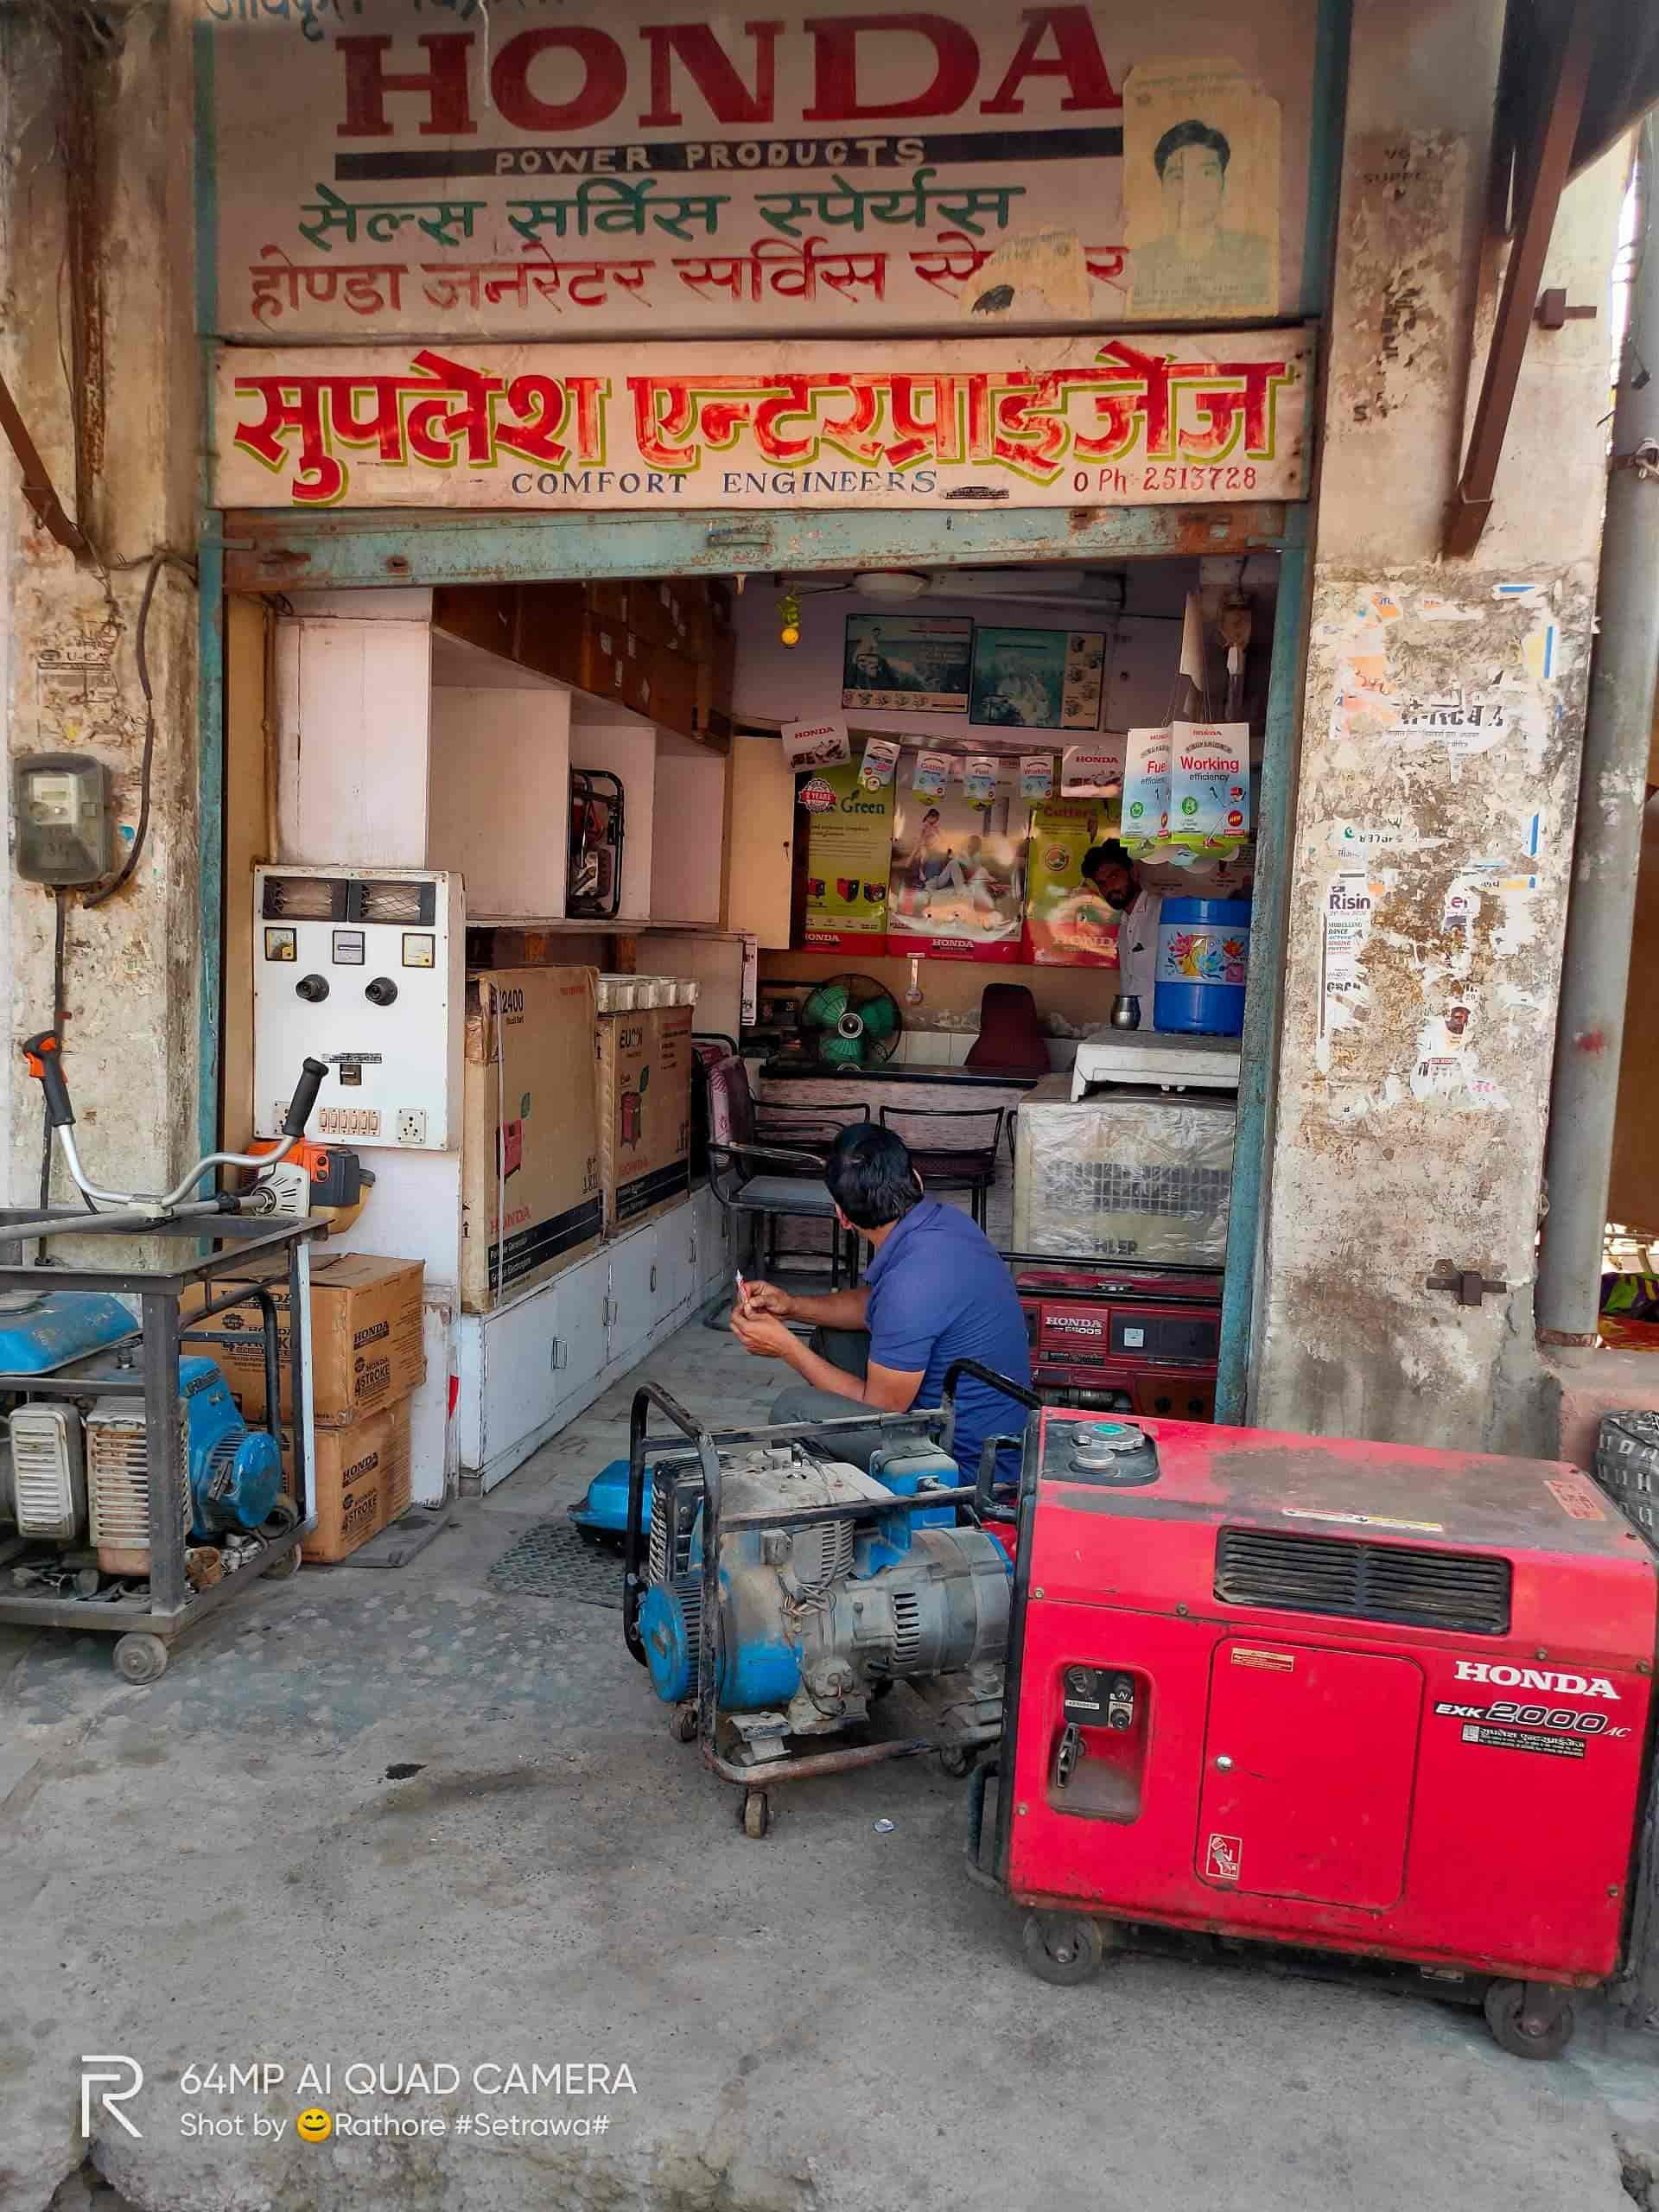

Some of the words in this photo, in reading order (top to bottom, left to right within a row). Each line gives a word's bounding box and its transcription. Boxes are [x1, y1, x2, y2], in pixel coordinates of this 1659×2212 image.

[335, 4, 1123, 137] HONDA
[494, 145, 650, 176] POWER
[686, 137, 928, 170] PRODUCTS
[297, 181, 487, 251] सेल्स
[505, 176, 731, 242] सर्विस
[249, 245, 409, 331] होण्डा
[421, 242, 656, 314] जनरेटर
[671, 234, 890, 304] सर्विस
[233, 348, 613, 507] सुपलेश
[511, 472, 688, 495] COMFORT
[722, 468, 939, 494] ENGINEERS
[1142, 466, 1257, 491] 2513728
[1076, 755, 1120, 765] HONDA
[1180, 755, 1240, 774] Working
[1189, 772, 1231, 783] efficiency
[841, 797, 886, 815] Green
[804, 933, 841, 943] ONDA
[931, 938, 975, 949] HONDA
[353, 1320, 390, 1344] HONDA
[1044, 1316, 1104, 1328] HONDA
[343, 1452, 378, 1481] HONDA
[1453, 1660, 1622, 1700] HONDA
[1434, 1703, 1484, 1719] EXK
[1485, 1700, 1609, 1734] 2000
[1605, 1726, 1633, 1738] AC
